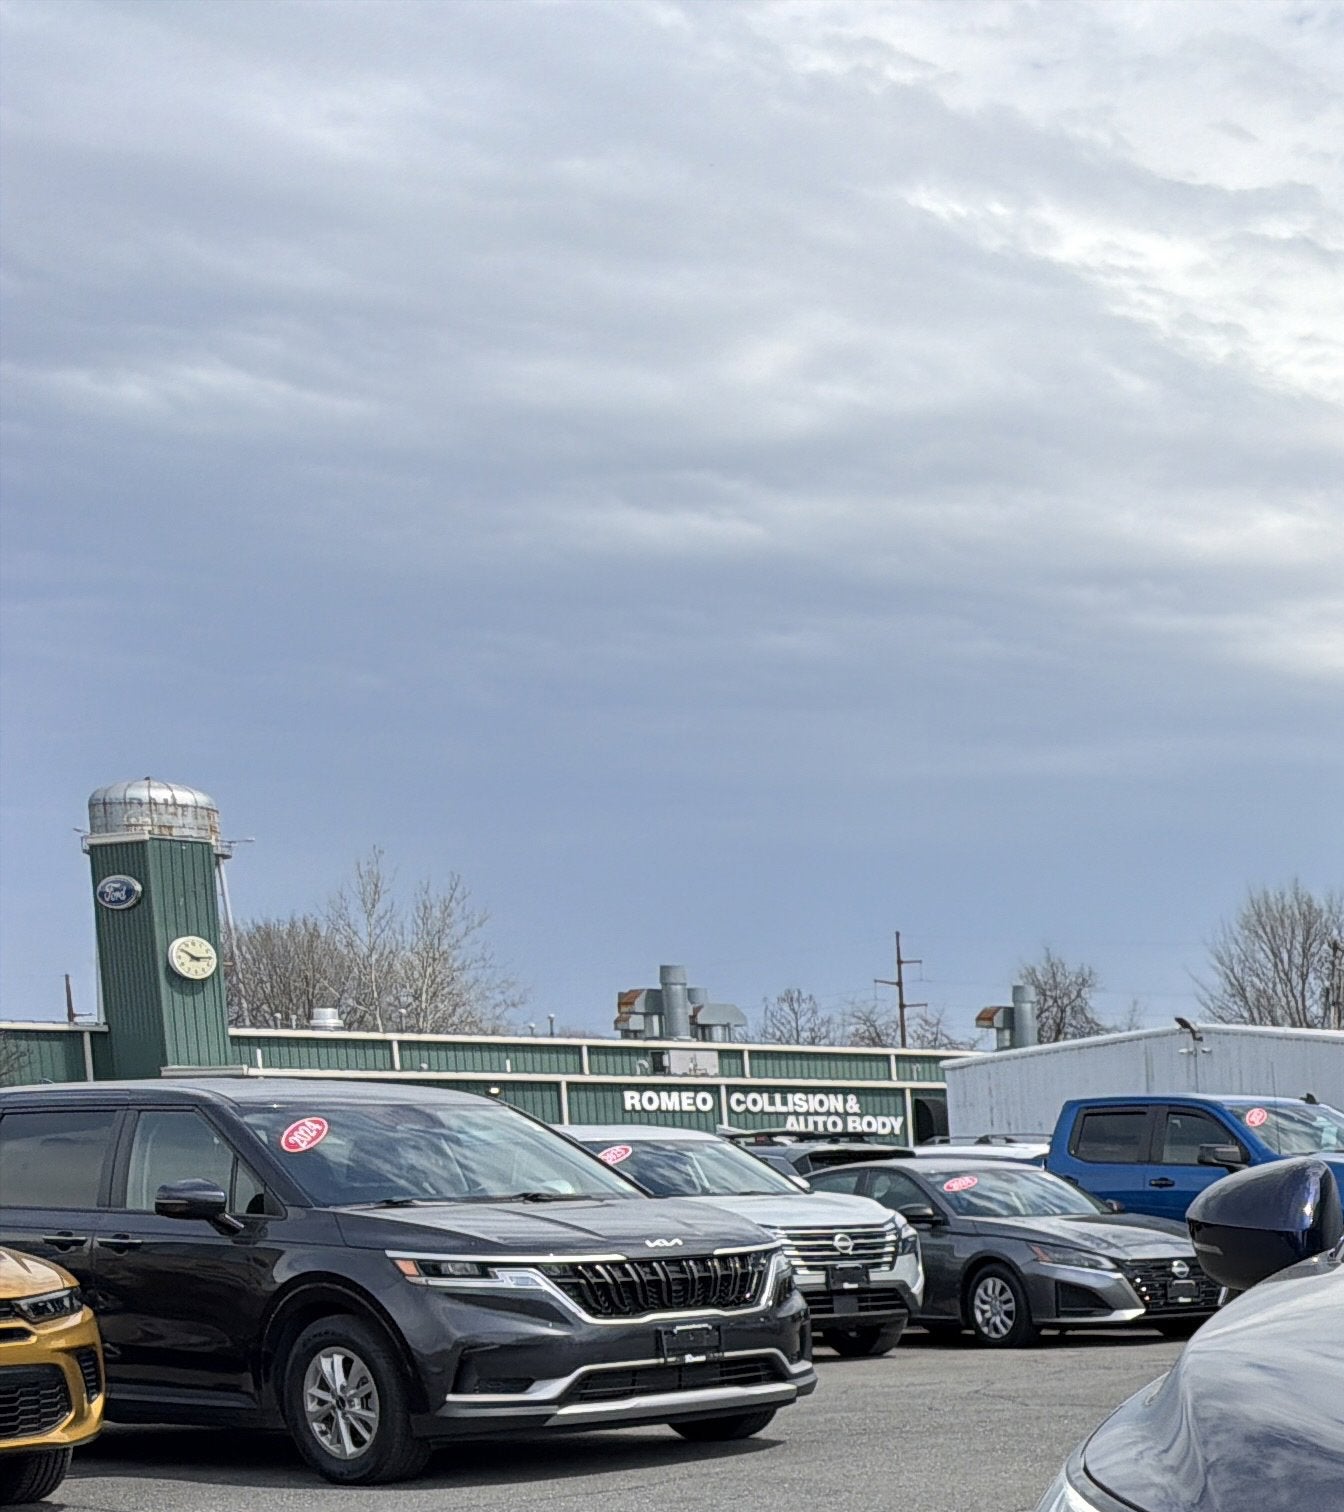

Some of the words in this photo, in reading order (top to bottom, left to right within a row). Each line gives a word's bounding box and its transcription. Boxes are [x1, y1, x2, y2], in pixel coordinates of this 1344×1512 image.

[104, 882, 127, 902] Ford
[623, 1090, 714, 1112] ROMEO
[730, 1092, 845, 1113] COLLISION
[287, 1119, 323, 1149] 2024
[785, 1115, 843, 1133] AUTO
[846, 1115, 904, 1135] BODY
